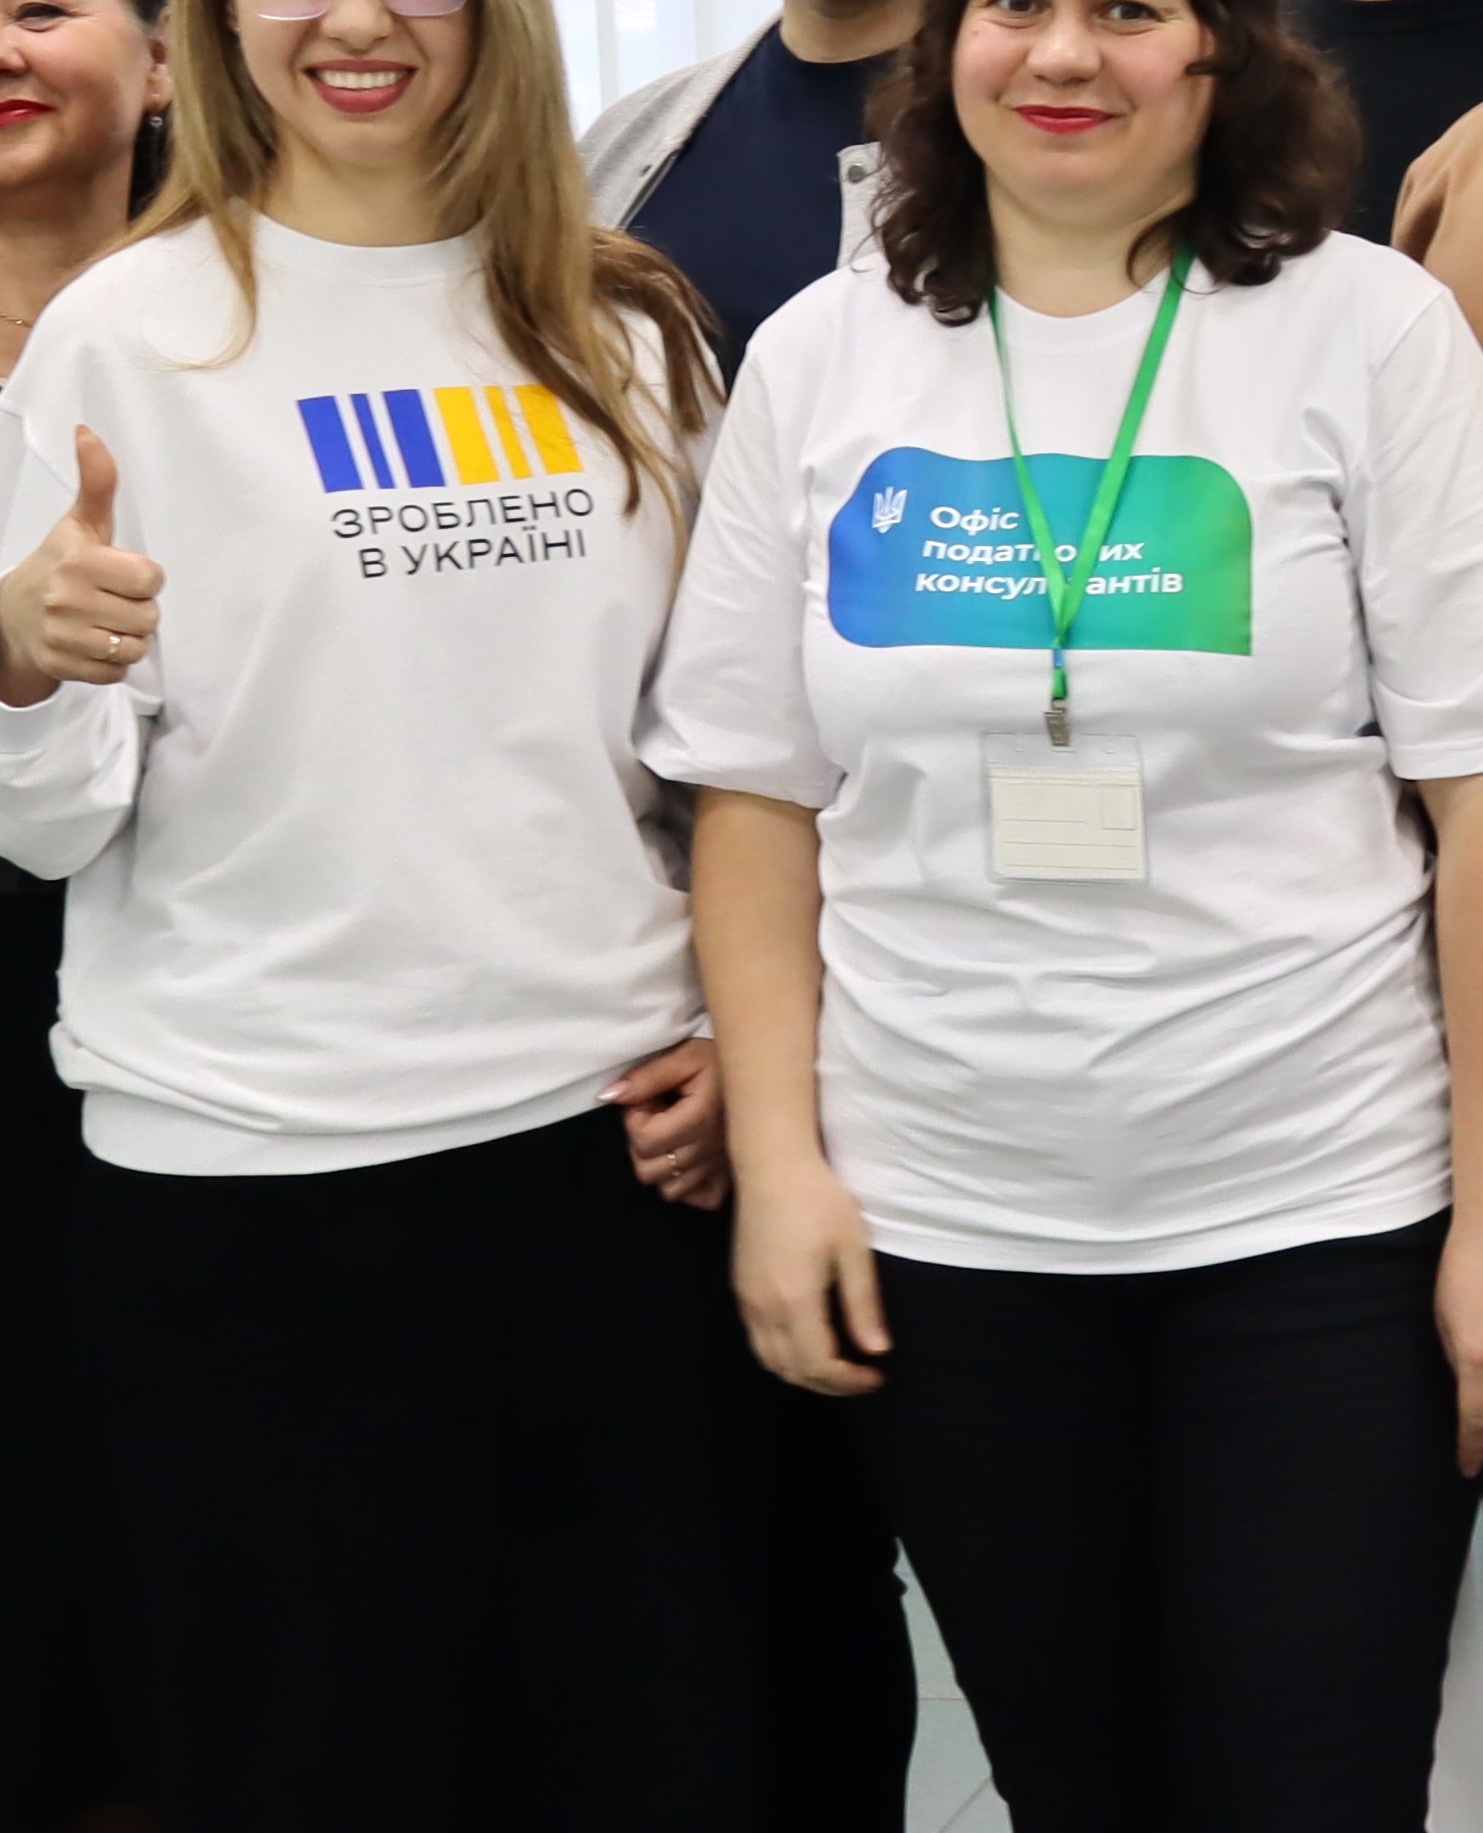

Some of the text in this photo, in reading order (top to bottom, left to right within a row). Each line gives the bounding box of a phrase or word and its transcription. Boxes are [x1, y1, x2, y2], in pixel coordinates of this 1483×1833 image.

[331, 488, 594, 539] ЗРОБЛЕНО
[929, 507, 1020, 536] Офіс
[359, 524, 586, 579] В УКРАЇНІ
[922, 540, 1146, 565] податоих
[915, 567, 1184, 600] консулантів
